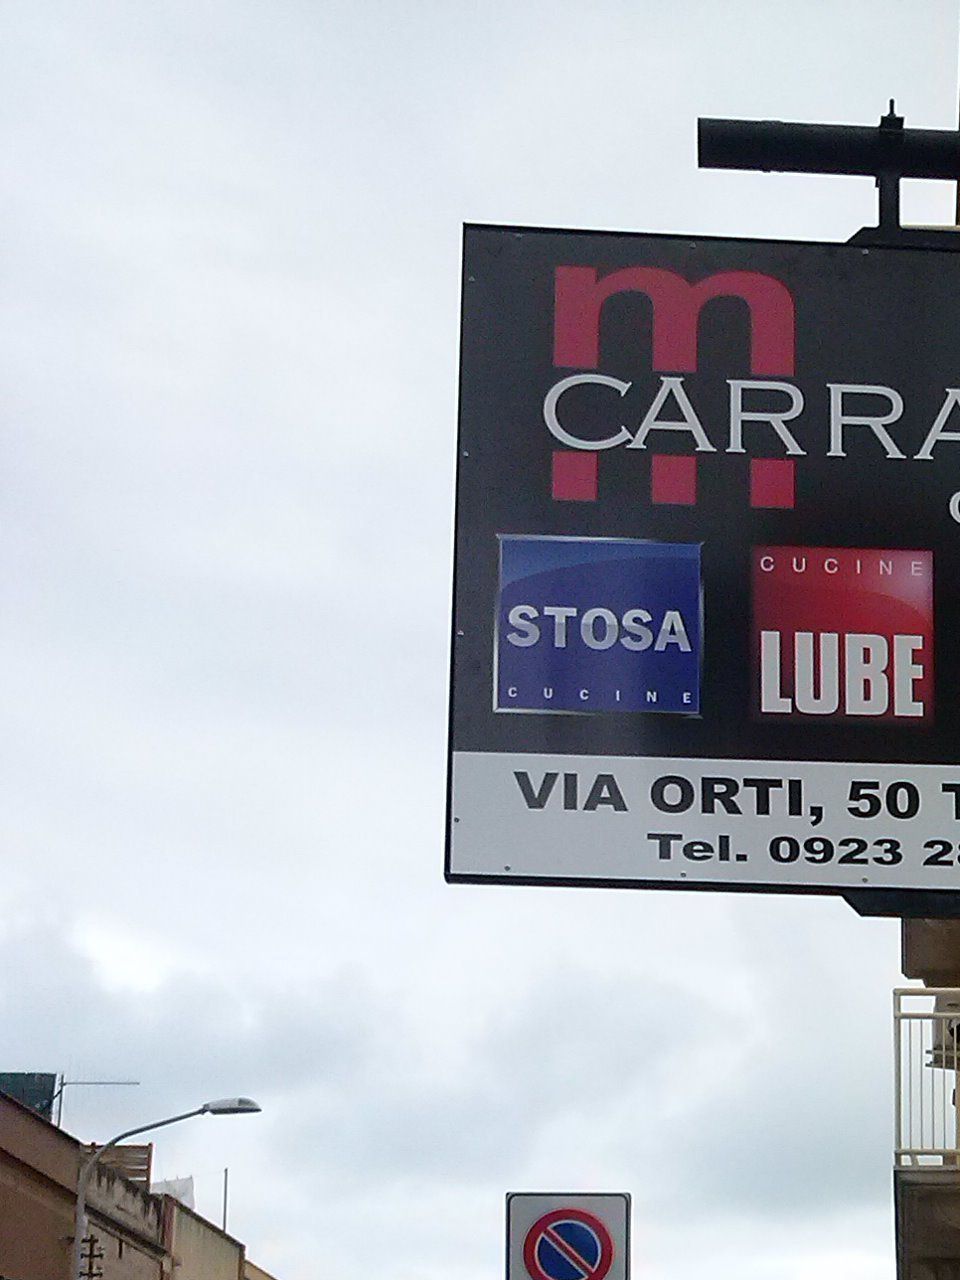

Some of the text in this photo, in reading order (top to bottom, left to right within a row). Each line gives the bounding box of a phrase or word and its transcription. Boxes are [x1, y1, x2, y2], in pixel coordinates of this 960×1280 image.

[760, 556, 924, 577] CUCINE
[506, 604, 693, 652] STOSA
[760, 630, 924, 717] LUBE
[508, 686, 692, 704] CUCINE
[513, 771, 629, 813] VIA
[649, 774, 825, 827] ORTI,
[846, 780, 920, 821] 50
[647, 832, 748, 863] Tel.
[769, 835, 903, 866] 0923
